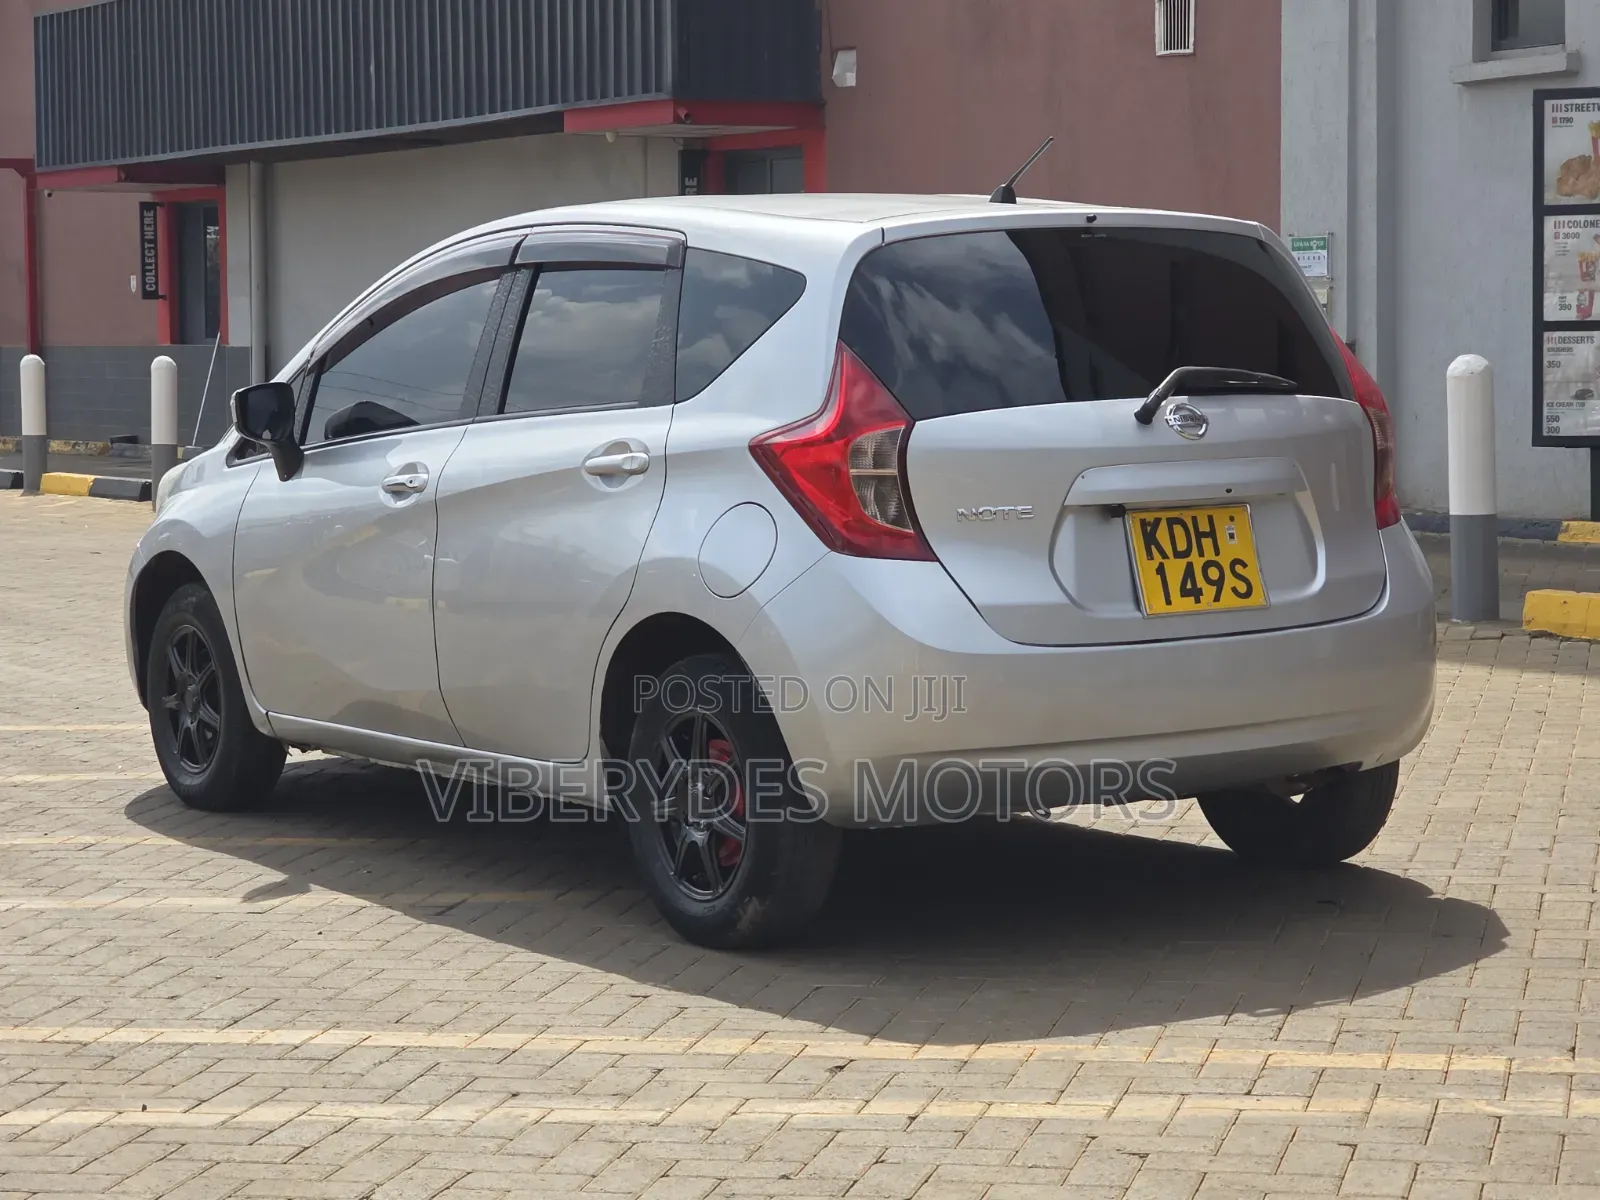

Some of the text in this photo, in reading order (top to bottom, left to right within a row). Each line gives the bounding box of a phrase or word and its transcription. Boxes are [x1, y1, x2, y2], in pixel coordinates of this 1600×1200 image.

[1562, 231, 1581, 240] 3000
[144, 209, 156, 291] COLLECT HERE
[1558, 303, 1572, 311] 390
[1557, 335, 1595, 345] DESSERTS
[1546, 360, 1561, 369] 350
[1545, 414, 1560, 423] 550
[1545, 425, 1561, 434] 300
[956, 505, 1035, 522] NOTE
[1139, 514, 1221, 561] KDH
[1155, 557, 1254, 606] 149S
